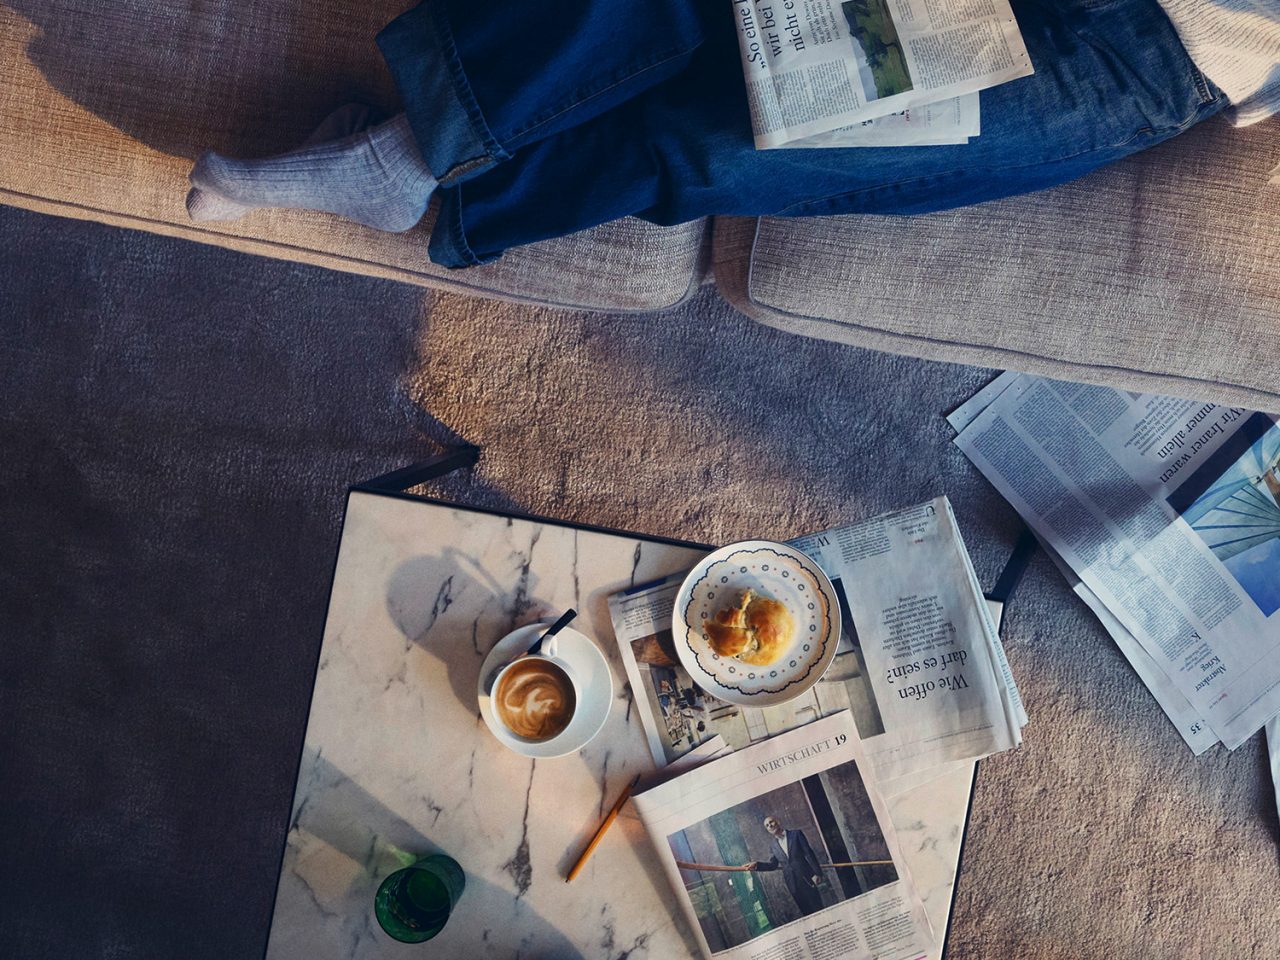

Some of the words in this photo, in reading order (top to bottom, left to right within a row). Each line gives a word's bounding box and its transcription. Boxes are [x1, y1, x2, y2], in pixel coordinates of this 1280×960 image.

[736, 8, 756, 38] eine
[758, 6, 776, 30] bei
[766, 32, 782, 58] wir
[784, 14, 805, 51] nicht
[743, 42, 766, 69] „So
[1156, 430, 1189, 460] allein
[1188, 421, 1225, 454] Iraner
[1158, 452, 1192, 484] waren
[887, 662, 920, 684] sein?
[923, 657, 938, 669] es
[941, 650, 967, 671] darf
[1200, 656, 1221, 672] Krieg
[898, 681, 935, 700] offen
[938, 674, 969, 690] Wie
[1195, 666, 1226, 692] Abstrakter
[1188, 722, 1203, 735] 35
[757, 740, 830, 774] WIRTSCHAFT
[835, 734, 846, 745] 19
